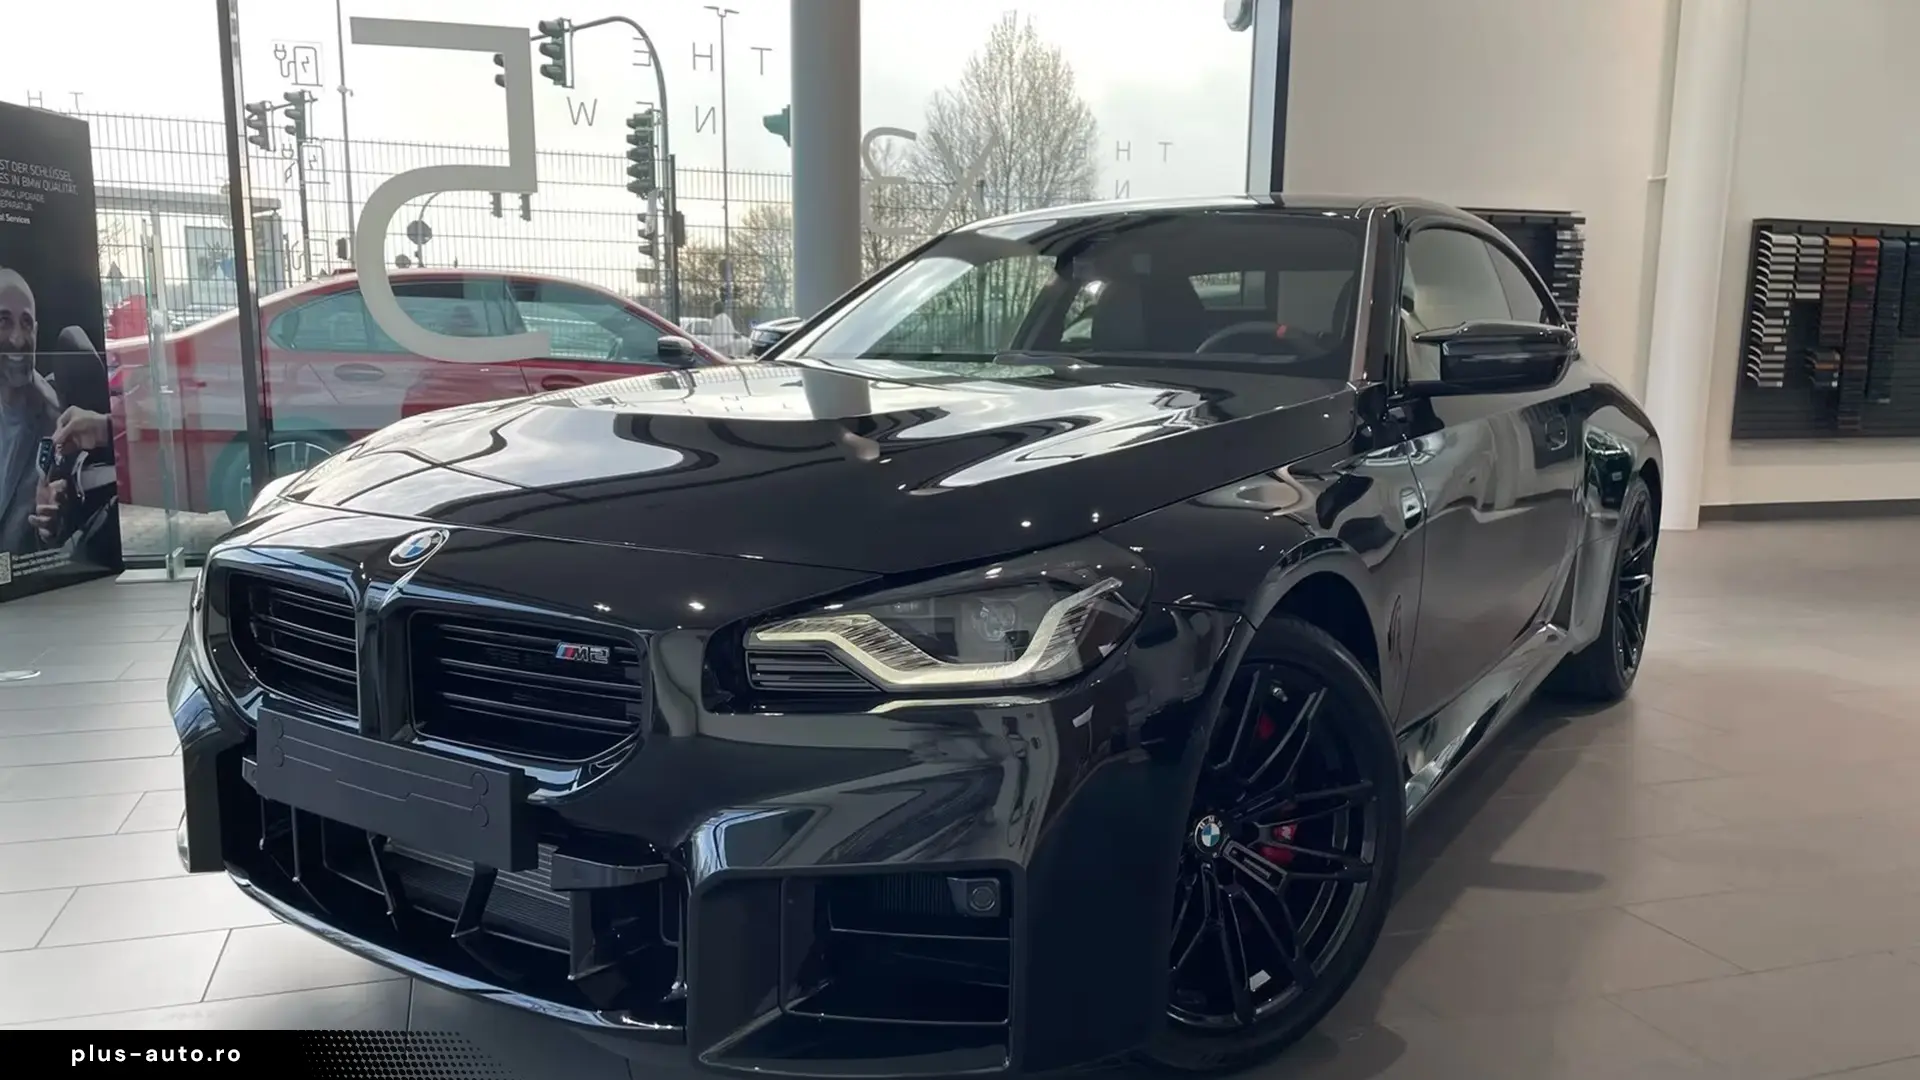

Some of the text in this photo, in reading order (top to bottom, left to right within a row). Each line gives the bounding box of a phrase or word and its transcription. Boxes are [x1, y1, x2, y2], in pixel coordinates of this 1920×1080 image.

[12, 161, 29, 175] DER
[11, 175, 20, 187] IN
[22, 177, 41, 190] BMW
[5, 214, 31, 225] Services
